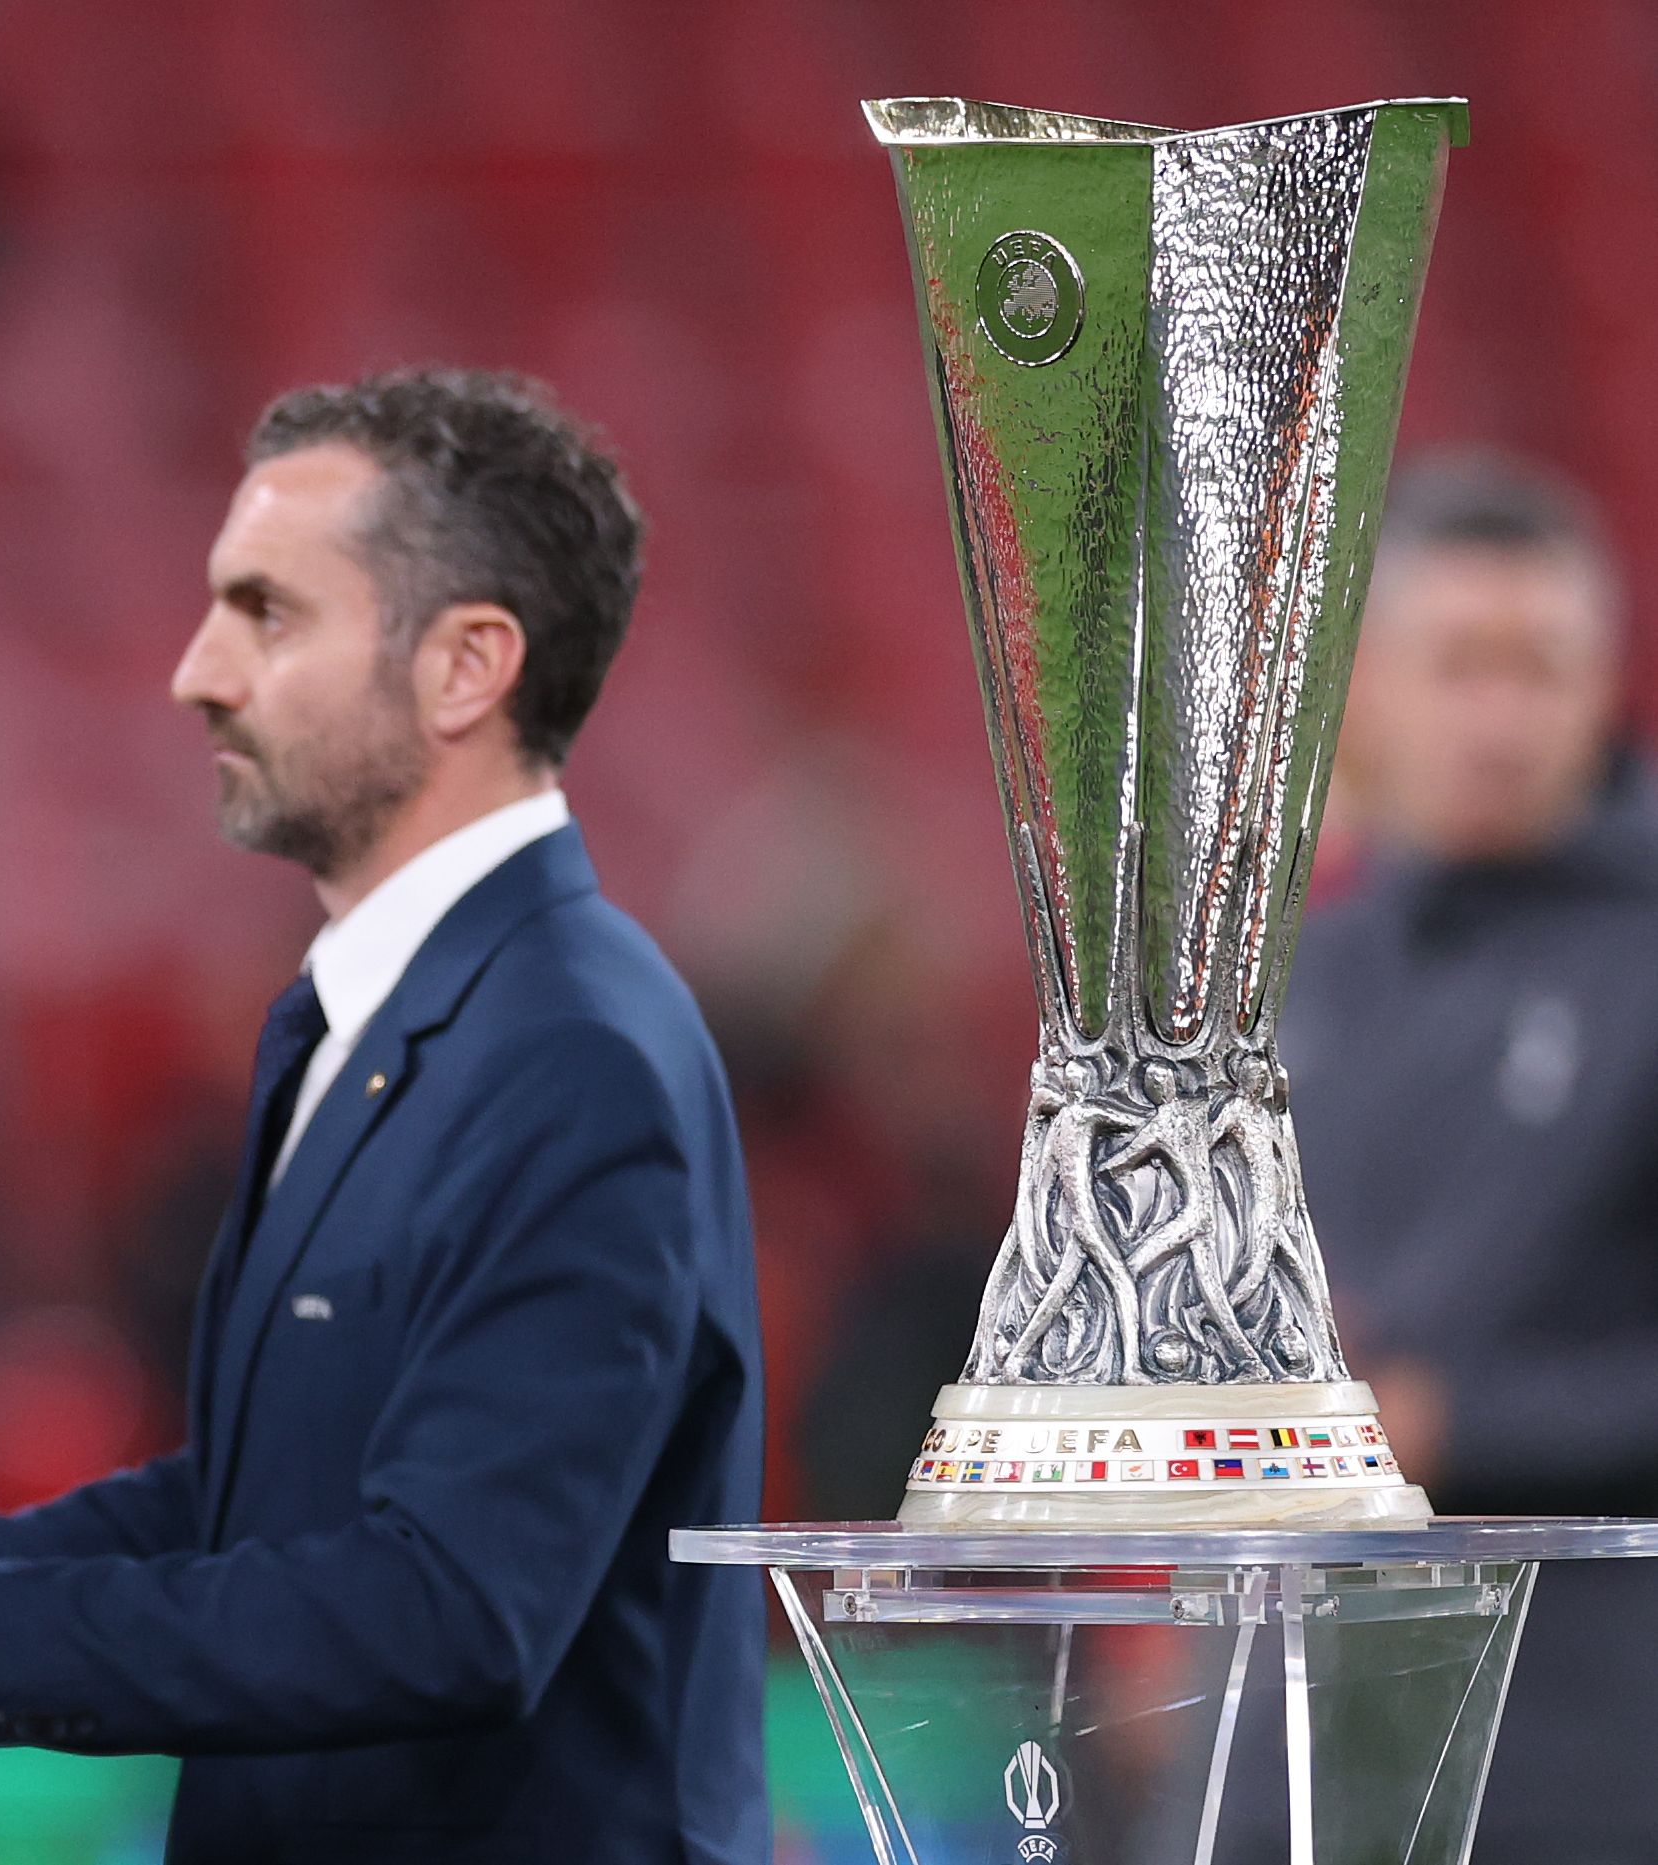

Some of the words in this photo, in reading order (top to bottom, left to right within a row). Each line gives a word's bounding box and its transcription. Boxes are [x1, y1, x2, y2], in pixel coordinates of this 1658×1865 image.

[992, 239, 1057, 271] UEFA
[921, 1428, 1002, 1453] COUPE
[1025, 1429, 1143, 1453] UEFA
[1019, 1839, 1054, 1860] UEFA
